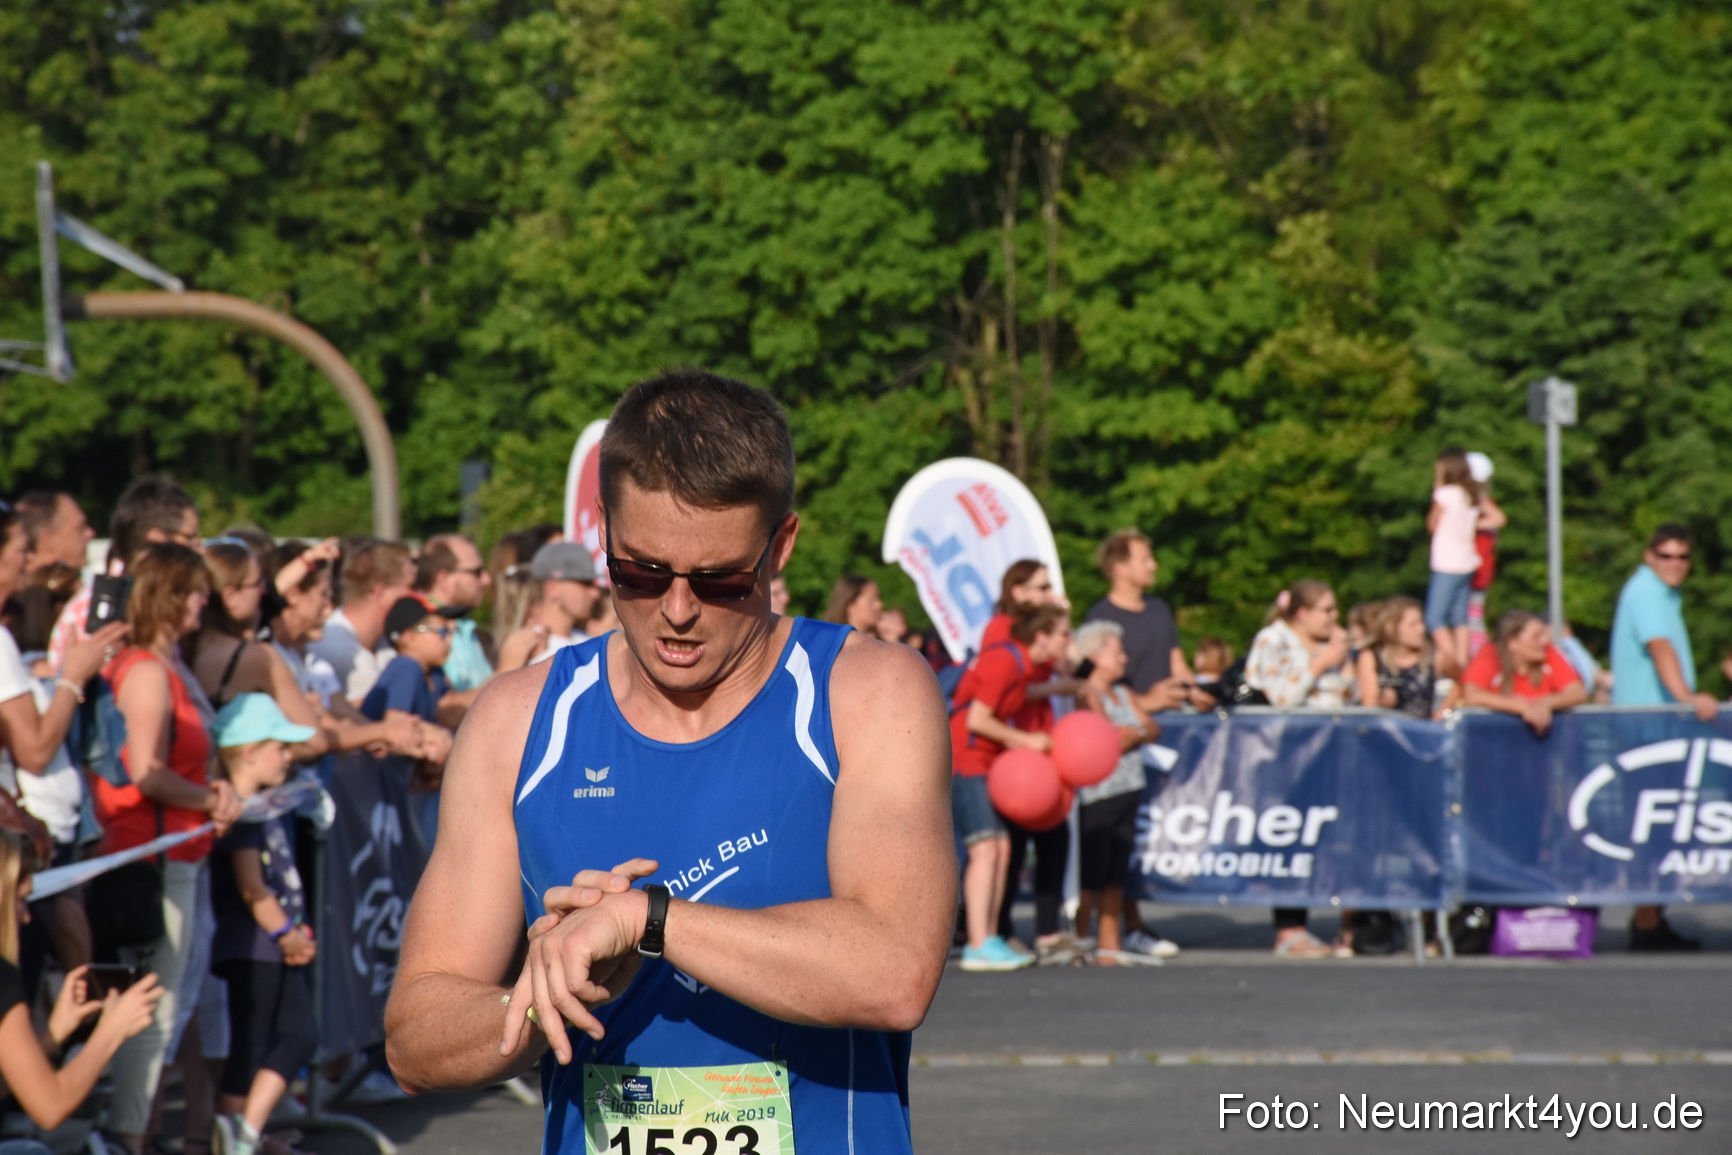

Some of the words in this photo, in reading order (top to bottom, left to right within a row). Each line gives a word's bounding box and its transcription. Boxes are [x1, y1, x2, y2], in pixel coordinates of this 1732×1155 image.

[573, 785, 616, 799] erima
[663, 857, 715, 898] hick
[717, 828, 769, 863] Bau
[611, 1098, 685, 1115] firmenlauf
[736, 1106, 776, 1122] 2019
[610, 1125, 761, 1155] 1523
